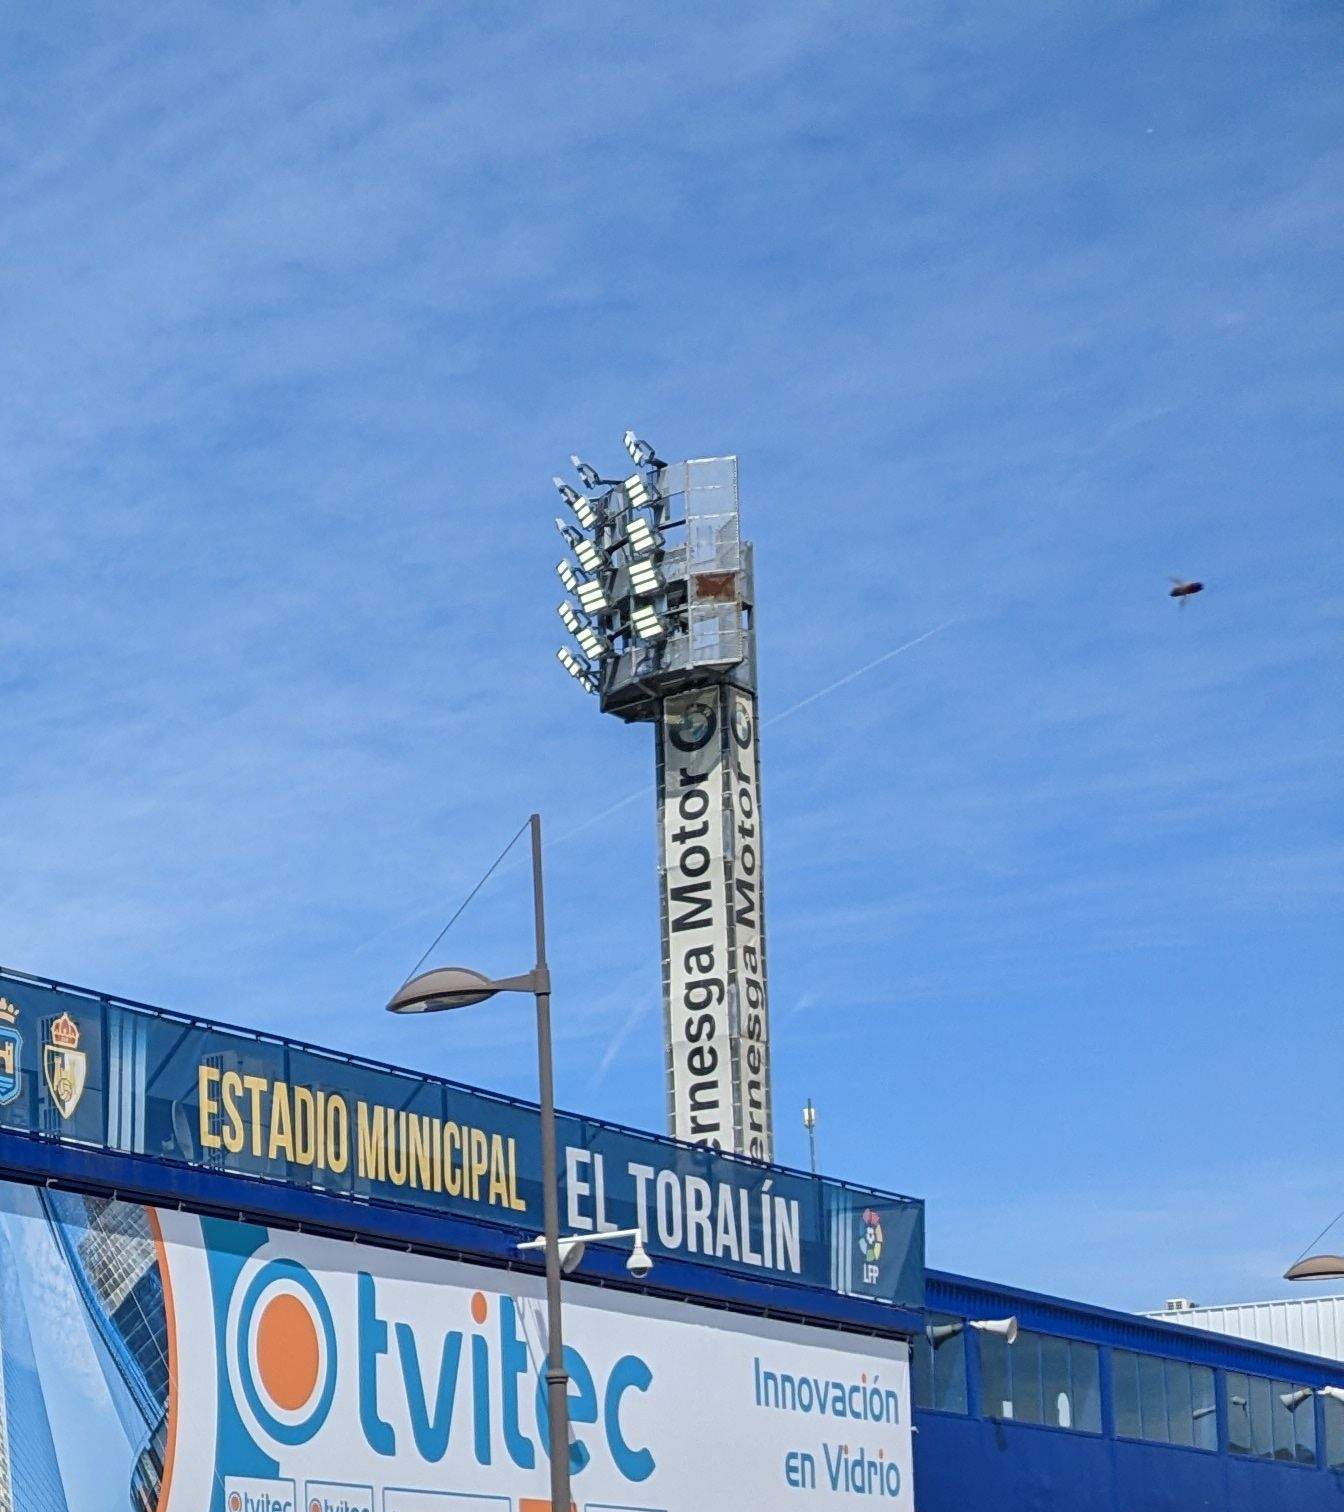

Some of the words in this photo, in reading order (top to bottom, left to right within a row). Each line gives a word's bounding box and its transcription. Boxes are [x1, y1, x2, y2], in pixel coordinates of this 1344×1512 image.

[671, 767, 713, 933] Motor
[735, 761, 757, 929] Motor
[683, 944, 725, 1152] rnesga
[743, 946, 764, 1161] ernesga
[198, 1065, 349, 1174] ESTADIO
[357, 1100, 527, 1212] MUNICIPAL
[565, 1146, 618, 1232] EL
[628, 1161, 801, 1274] TORALÍN
[863, 1264, 880, 1284] LFP
[357, 1271, 656, 1482] tvitec
[753, 1357, 900, 1425] Innovación
[785, 1451, 816, 1489] en
[823, 1443, 901, 1497] Vidrio
